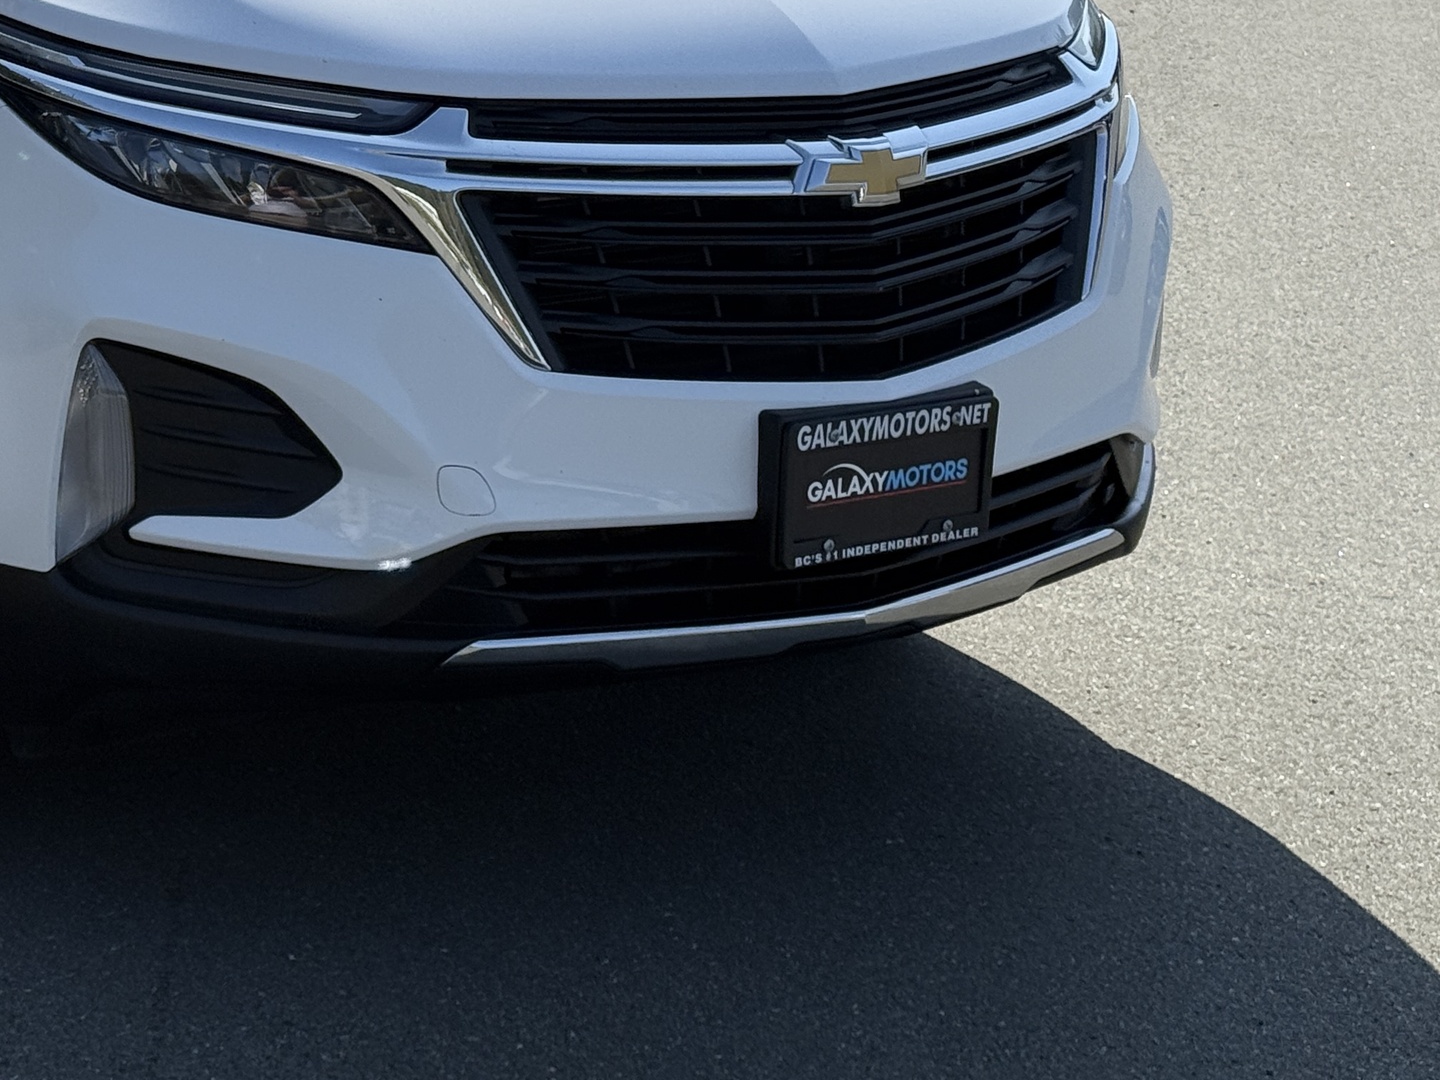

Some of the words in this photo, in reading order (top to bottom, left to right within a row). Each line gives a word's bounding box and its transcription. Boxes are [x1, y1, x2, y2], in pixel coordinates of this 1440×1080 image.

[796, 402, 991, 452] GALAXYMOTORSNET
[795, 552, 823, 568] BC'S
[842, 535, 929, 559] INDEPENDENT
[932, 526, 979, 544] DEALER
